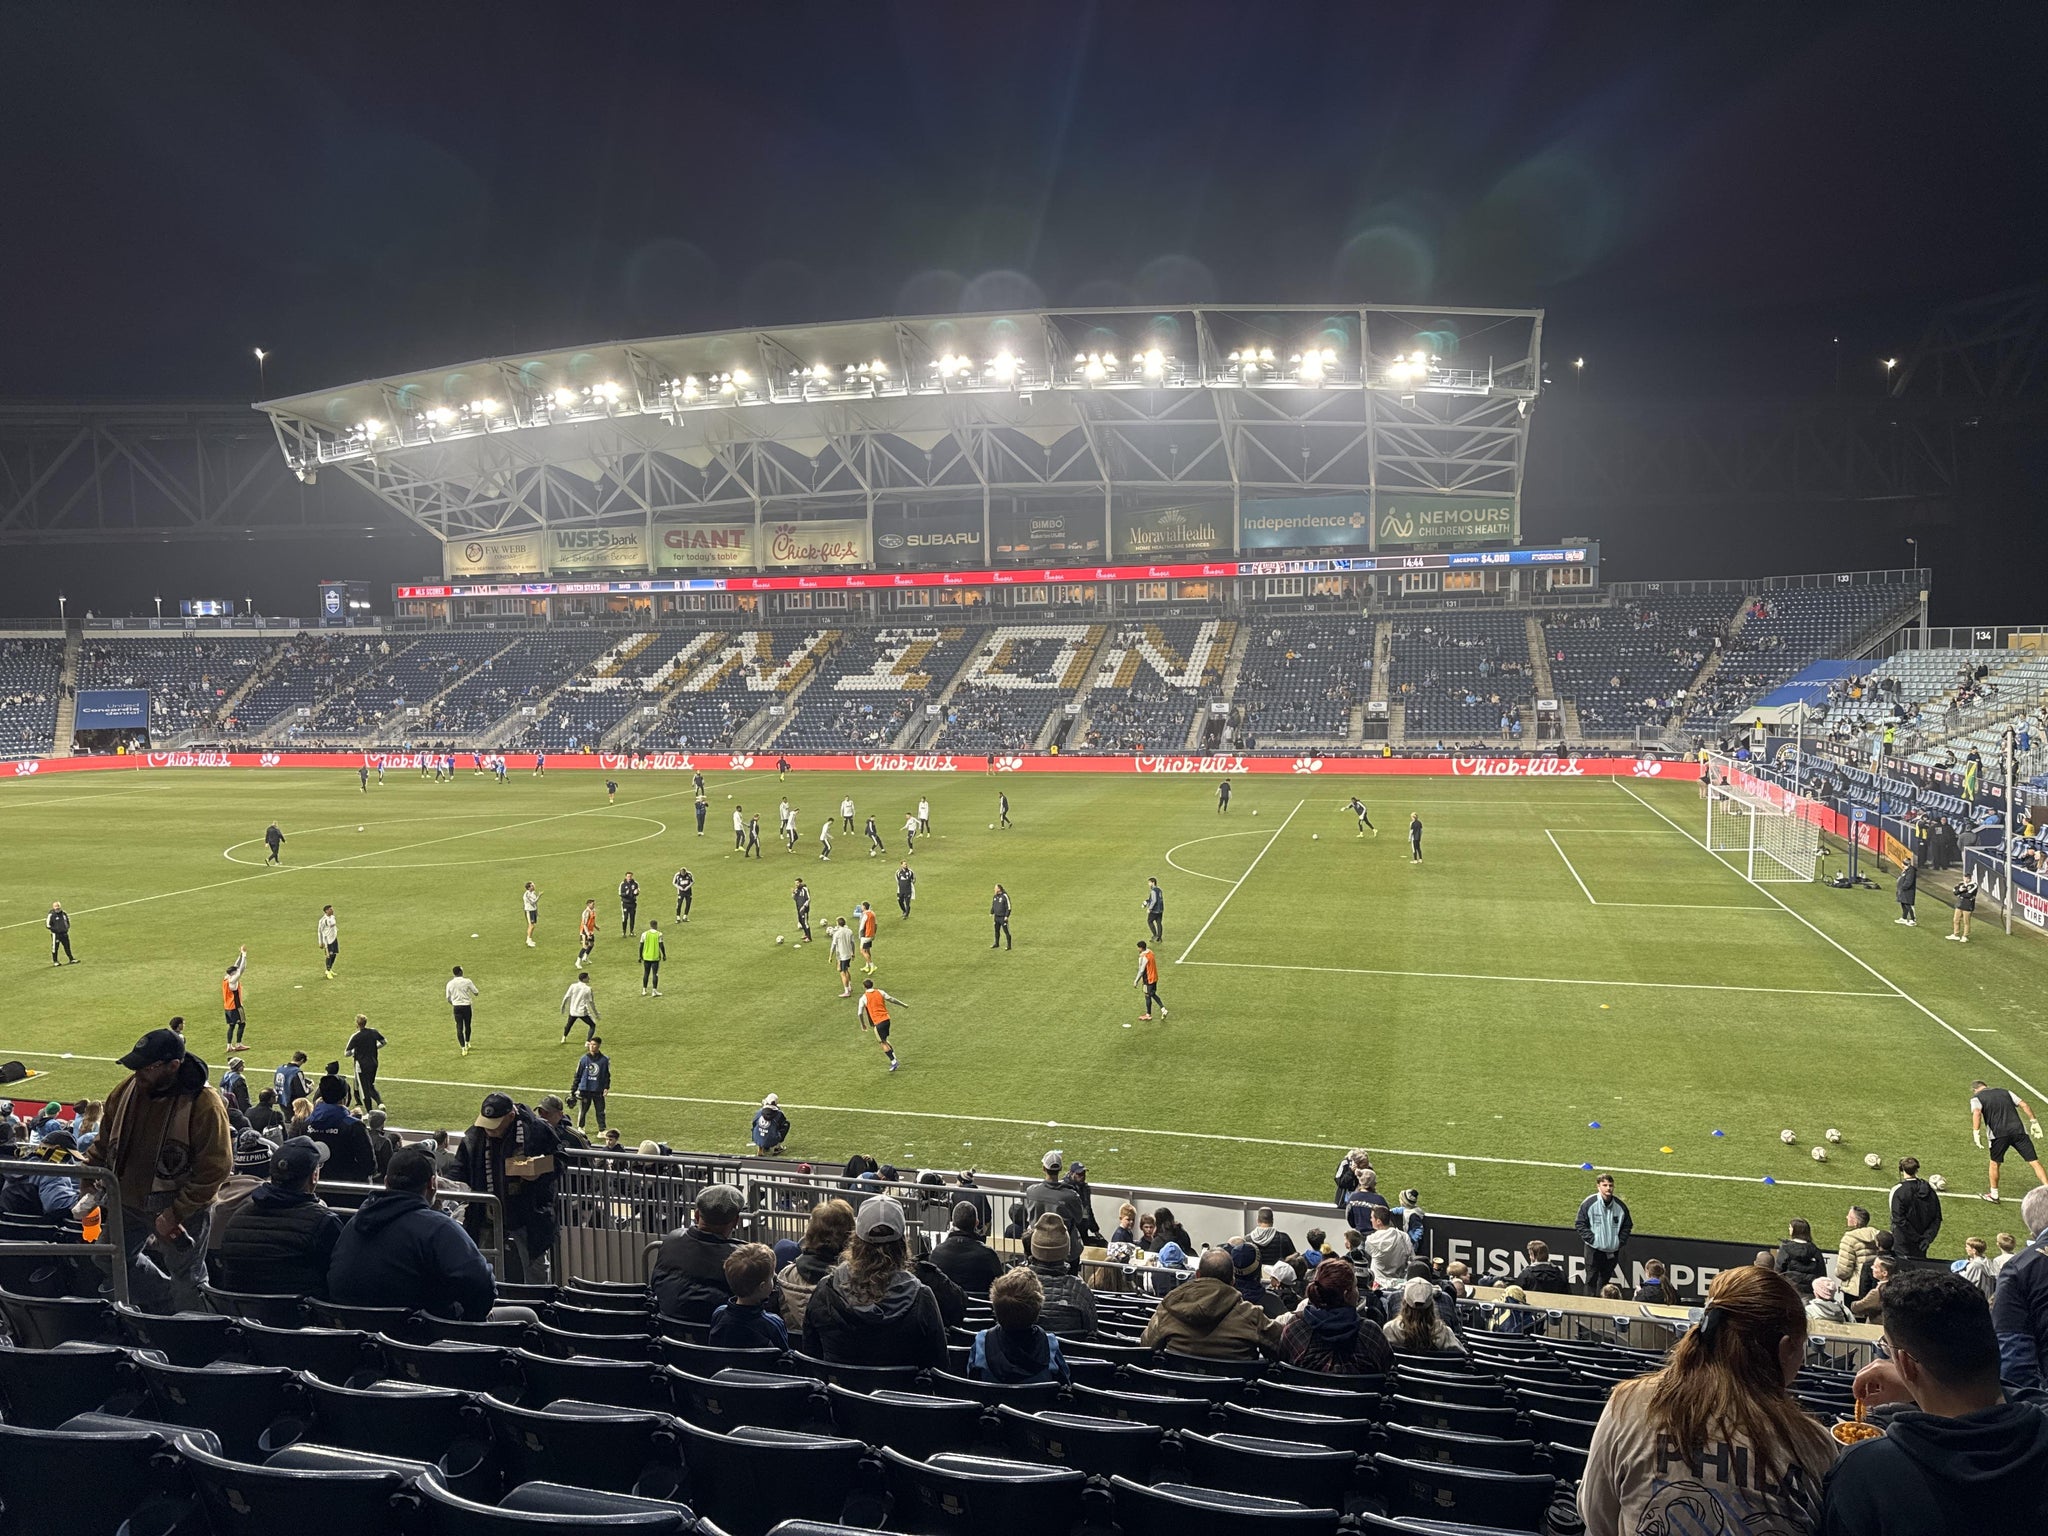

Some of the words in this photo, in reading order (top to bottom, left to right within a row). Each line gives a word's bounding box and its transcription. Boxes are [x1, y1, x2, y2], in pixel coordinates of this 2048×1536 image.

[1419, 507, 1511, 524] NEMOURS
[1032, 519, 1063, 529] BIMBO
[1243, 515, 1346, 531] Independence
[1418, 525, 1473, 537] CHILDREN'S
[1474, 523, 1510, 535] HEALTH
[556, 530, 610, 548] WSFS
[611, 532, 638, 546] bank
[663, 529, 745, 549] GIANT
[906, 532, 980, 546] SUBARU
[1130, 523, 1216, 544] MoraviaHealth
[501, 545, 526, 553] WEBB
[772, 527, 858, 563] Chick-fil-A
[610, 552, 639, 561] Service
[673, 552, 685, 561] for
[686, 552, 716, 562] today's
[717, 552, 738, 561] table
[1402, 558, 1424, 567] 14:44
[1481, 553, 1510, 564] $4,000
[1975, 631, 1991, 640] 134
[562, 622, 1235, 692] UNION
[2026, 908, 2042, 924] TIRE
